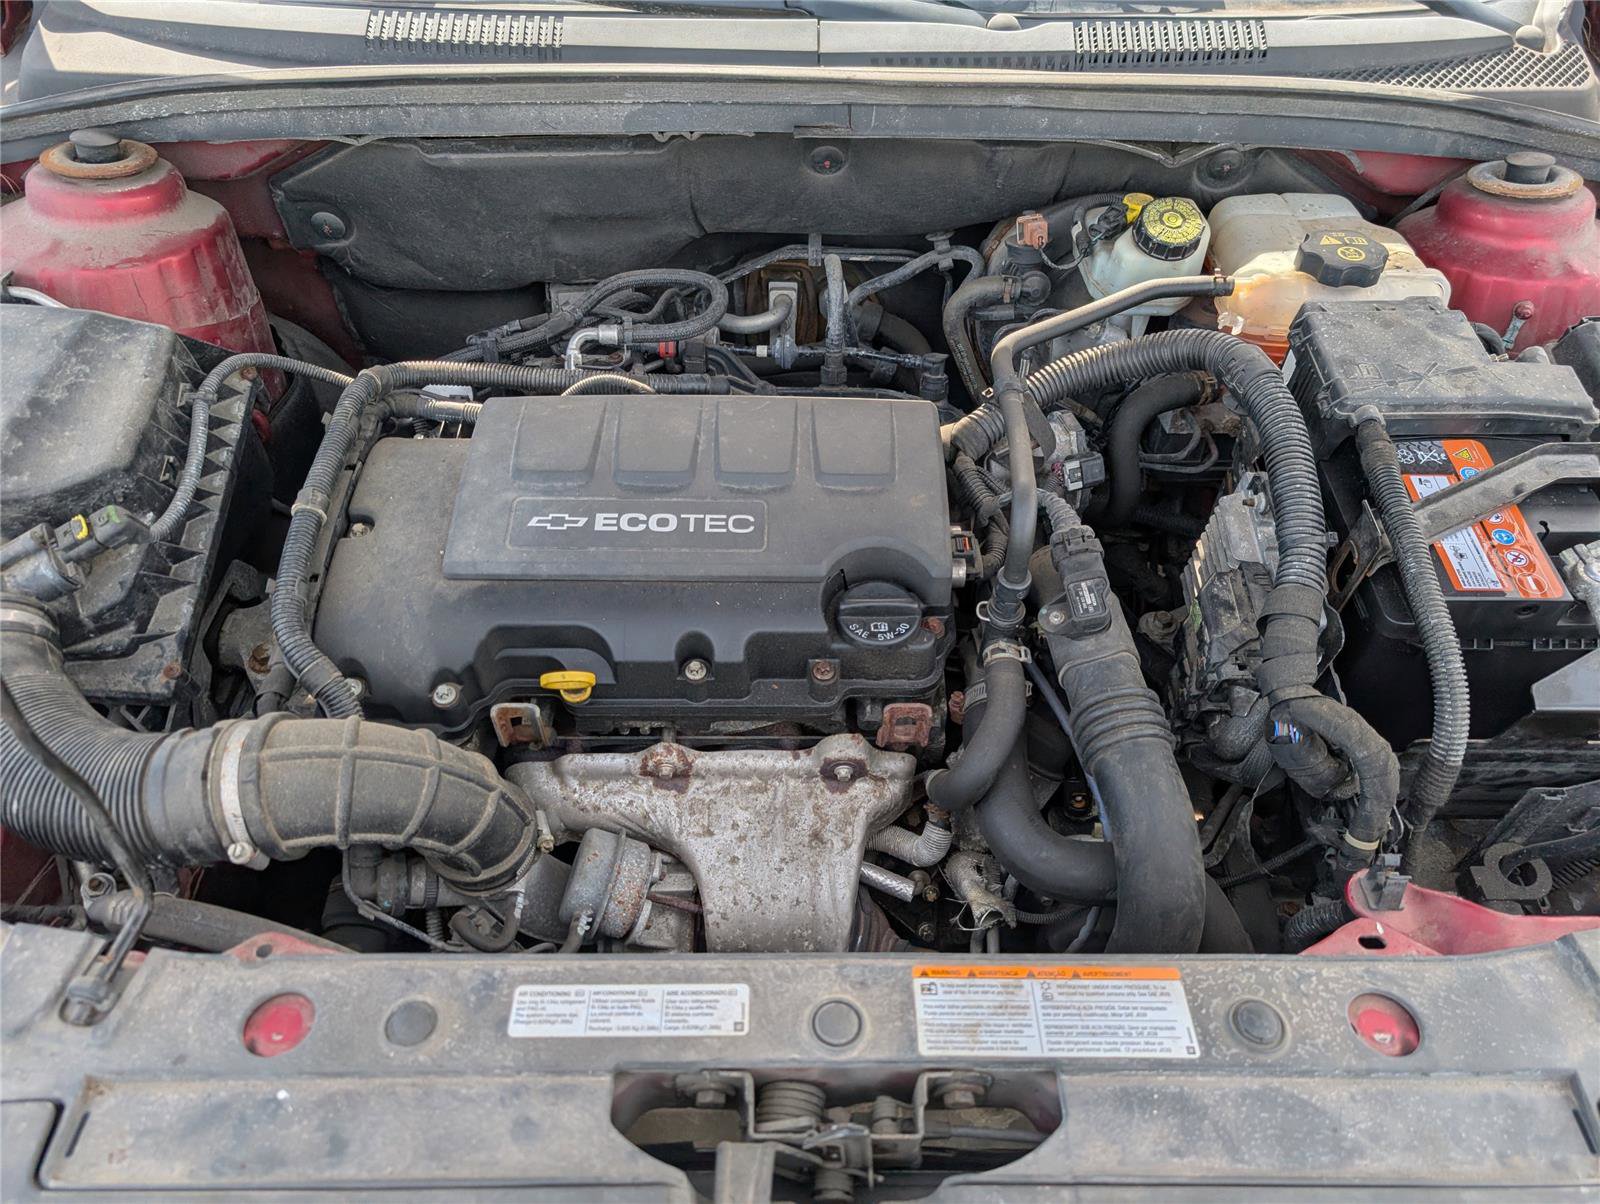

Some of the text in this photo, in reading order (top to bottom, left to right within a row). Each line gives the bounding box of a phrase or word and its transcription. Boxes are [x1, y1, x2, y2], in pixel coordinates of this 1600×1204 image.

[594, 512, 755, 533] ECOTEC
[849, 622, 910, 641] SAE 5W-30
